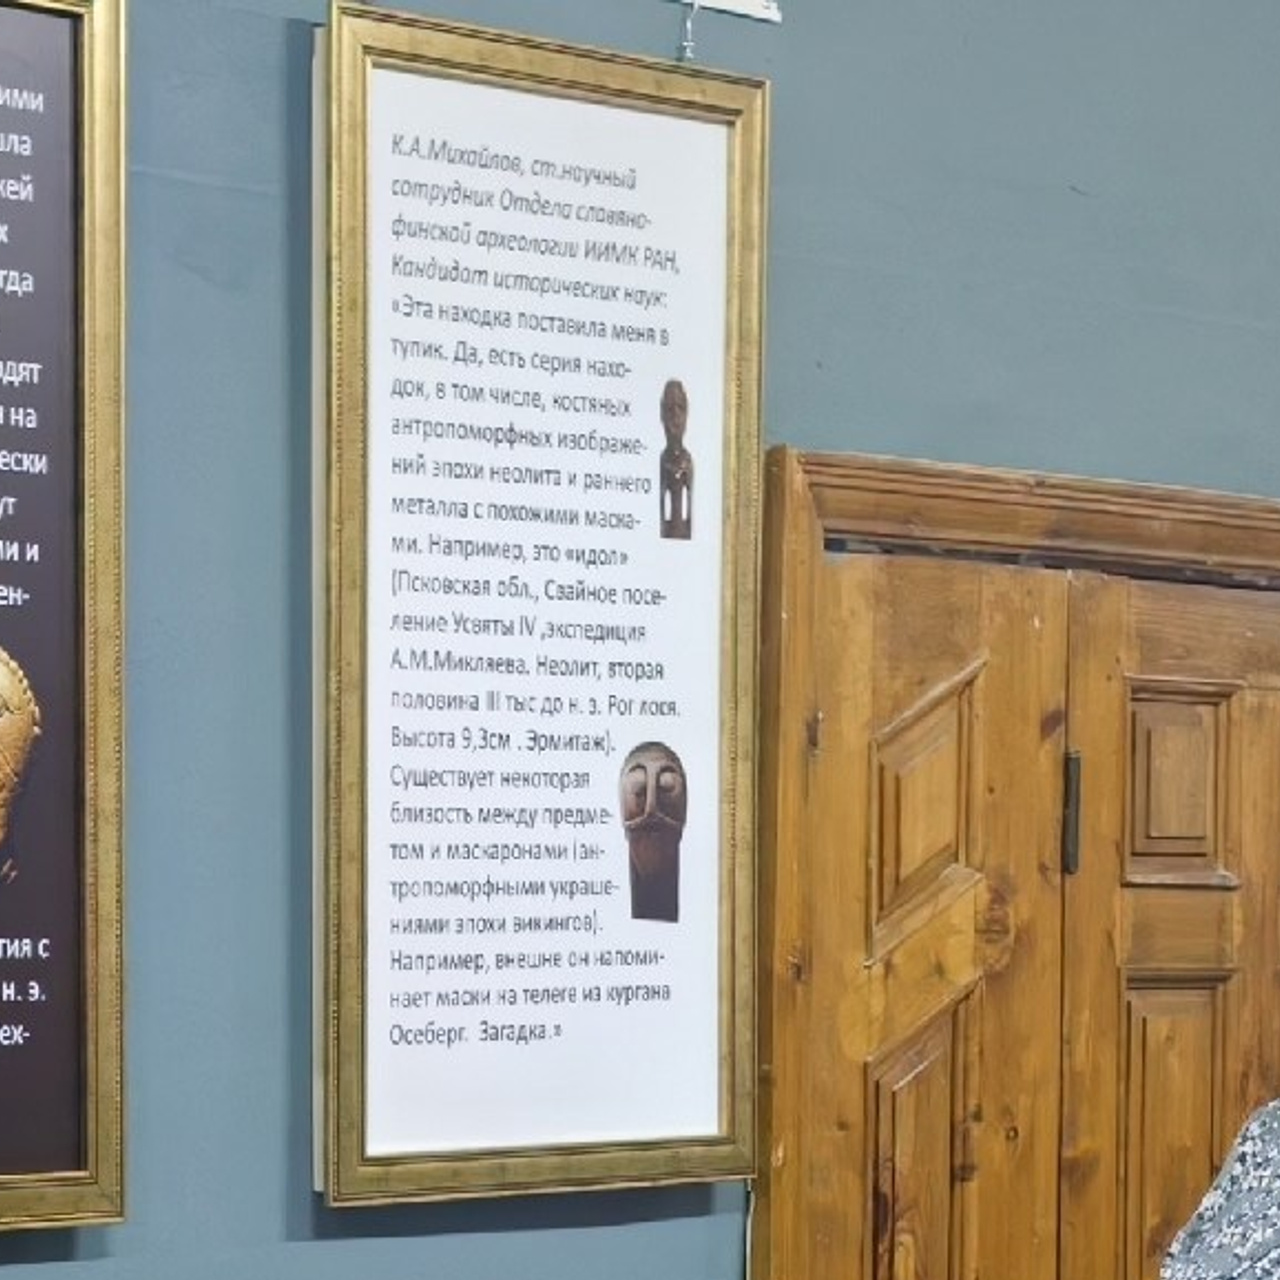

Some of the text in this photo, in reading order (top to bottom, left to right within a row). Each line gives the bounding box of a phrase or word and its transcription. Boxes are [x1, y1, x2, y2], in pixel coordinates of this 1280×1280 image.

[37, 938, 50, 960] с
[1, 980, 23, 1002] н.
[27, 980, 46, 1002] э.
